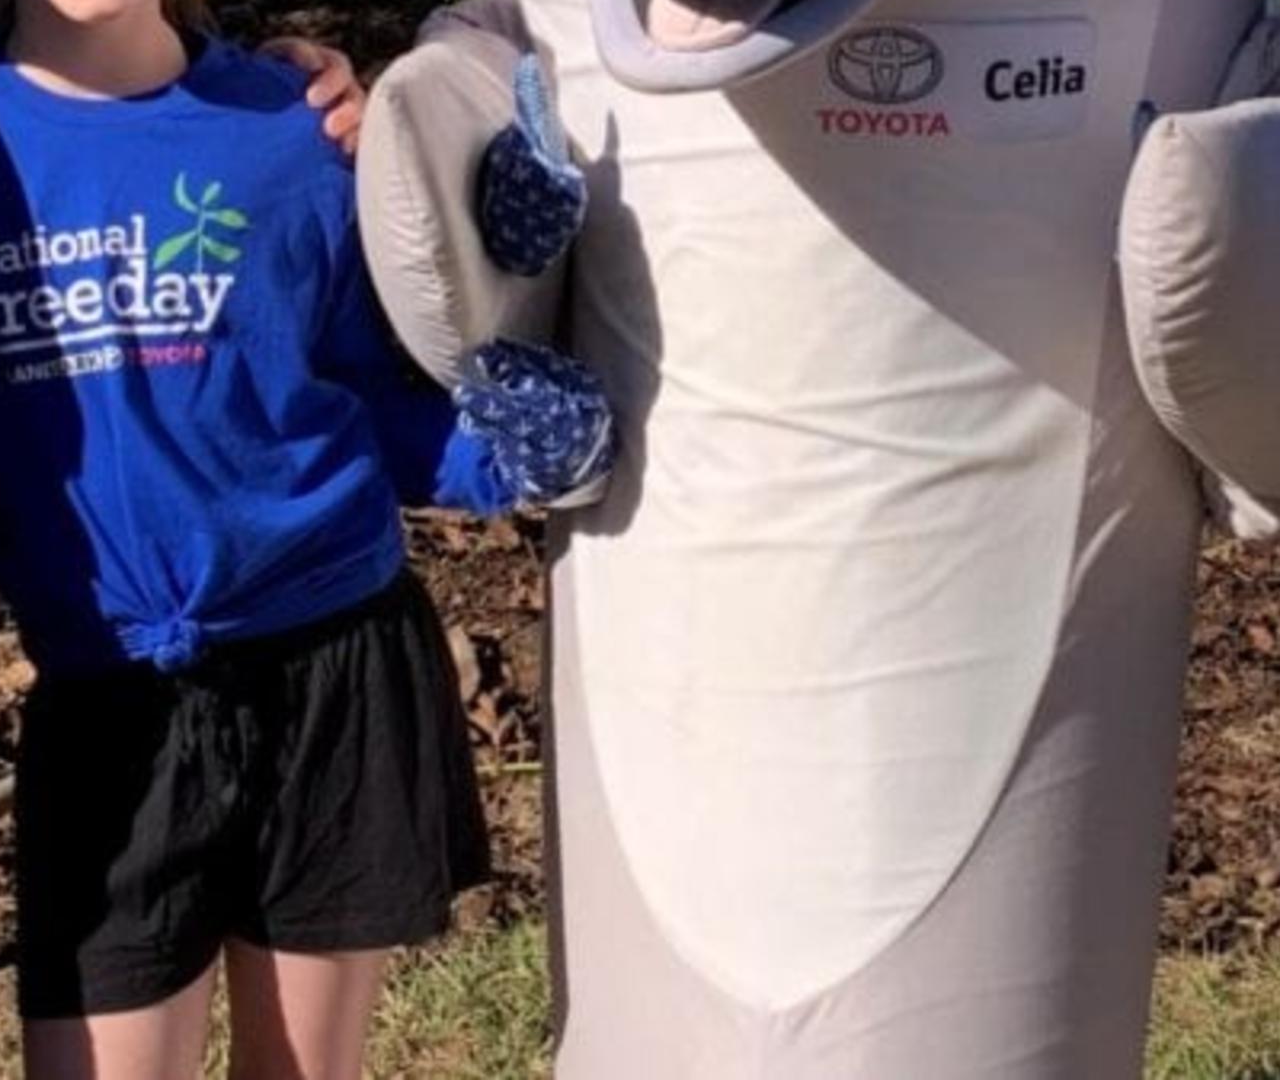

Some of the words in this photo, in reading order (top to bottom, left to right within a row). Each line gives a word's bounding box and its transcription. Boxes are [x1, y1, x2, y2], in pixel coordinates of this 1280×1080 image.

[983, 56, 1086, 103] Celia
[817, 108, 950, 137] TOYOTA
[107, 257, 235, 333] day
